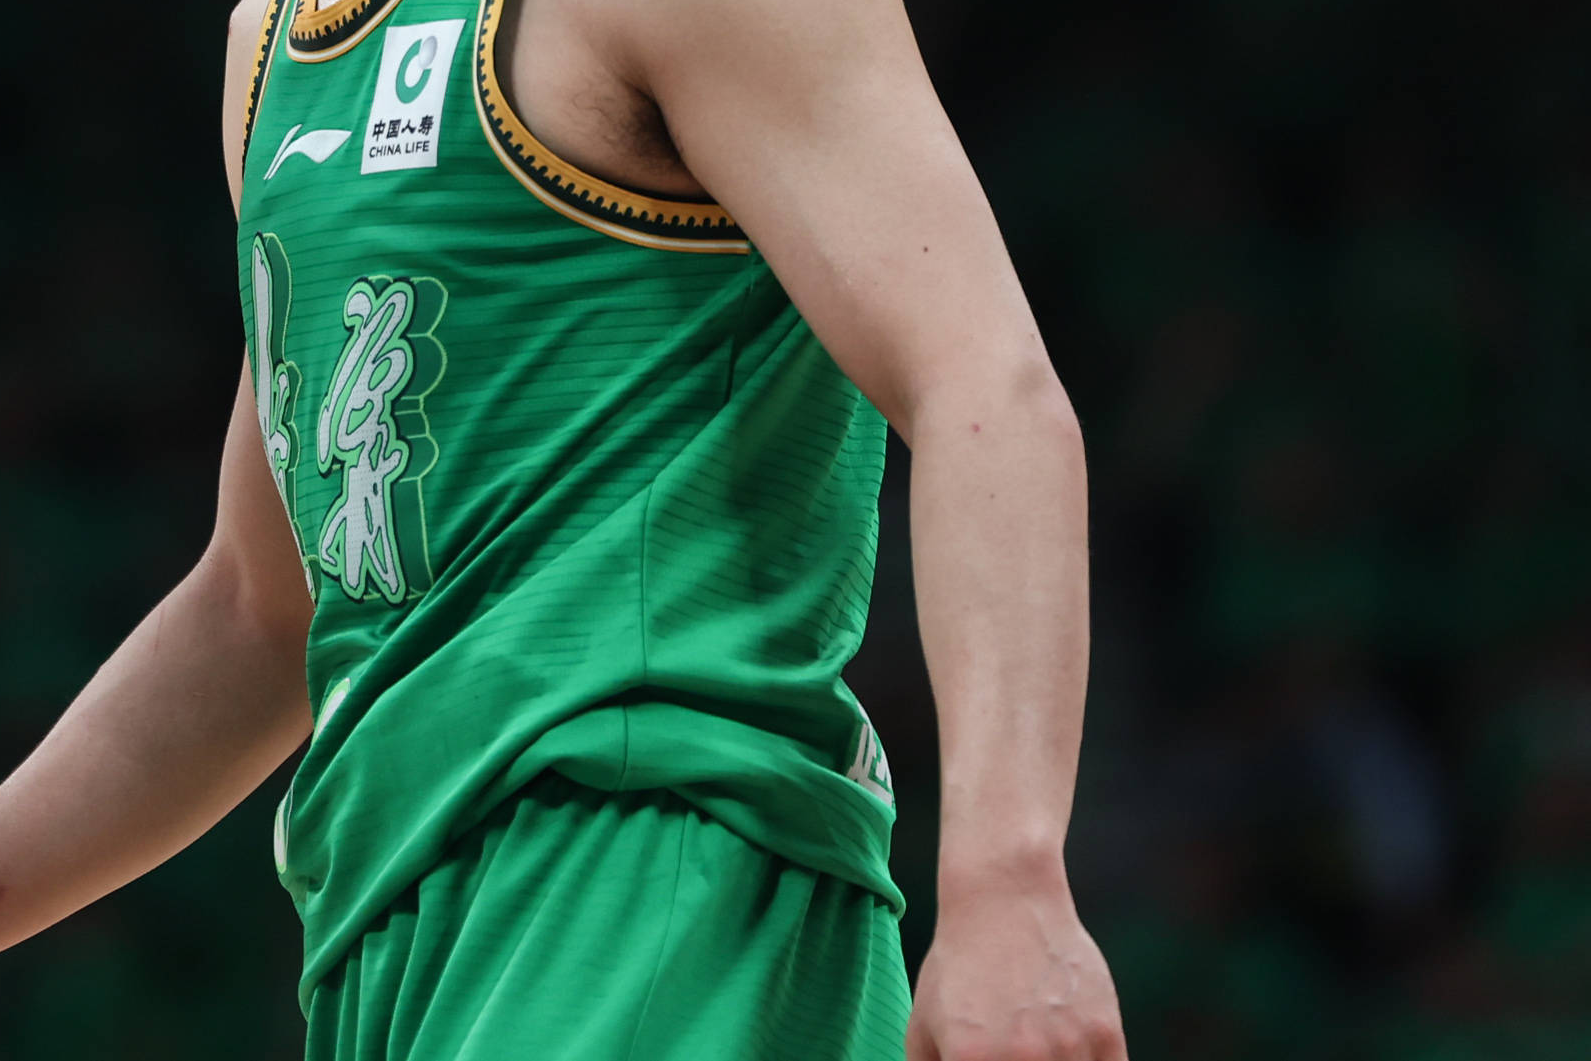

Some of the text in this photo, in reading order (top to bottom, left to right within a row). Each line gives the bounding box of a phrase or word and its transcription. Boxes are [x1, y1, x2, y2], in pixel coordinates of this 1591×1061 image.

[372, 115, 435, 141] 中国人寿
[369, 140, 430, 158] CHINA LIFE
